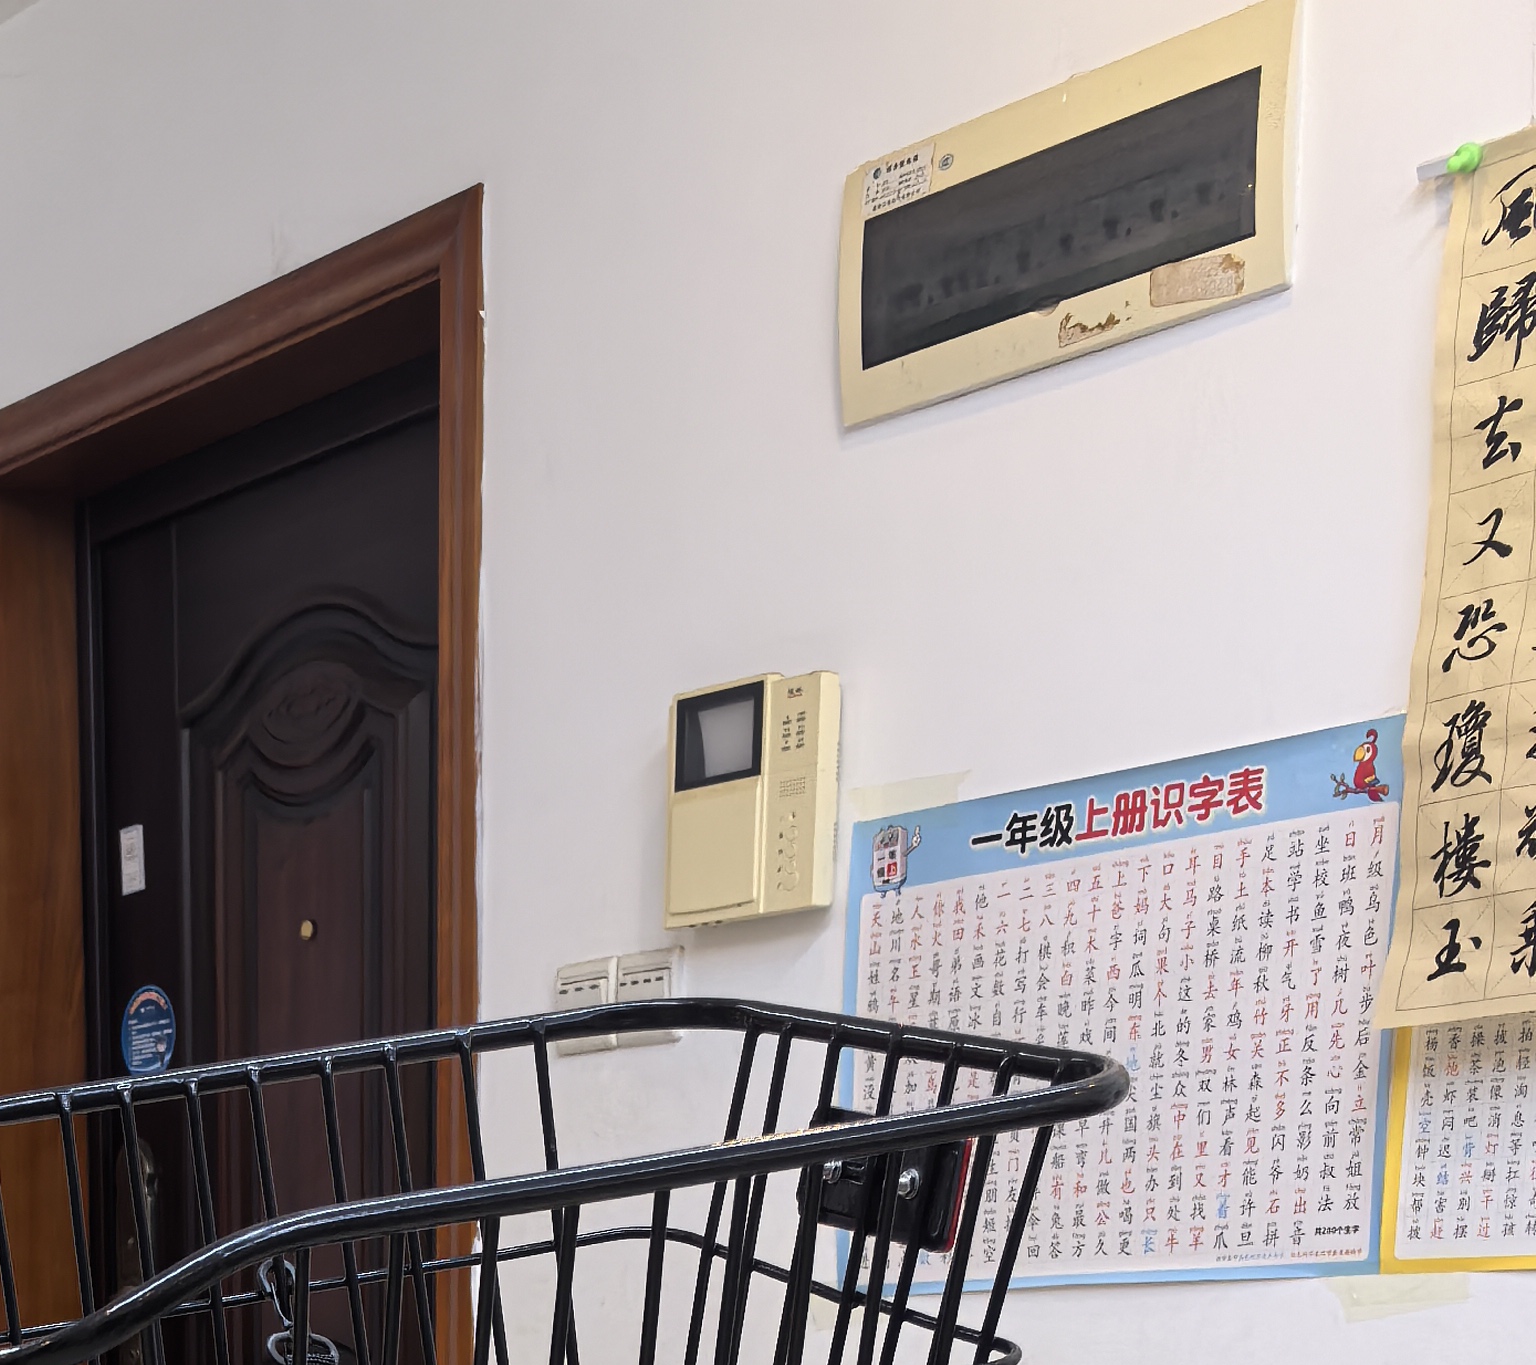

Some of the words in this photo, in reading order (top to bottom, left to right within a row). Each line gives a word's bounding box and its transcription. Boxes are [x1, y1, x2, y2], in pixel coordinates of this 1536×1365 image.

[971, 766, 1266, 855] 一年级上册识字表
